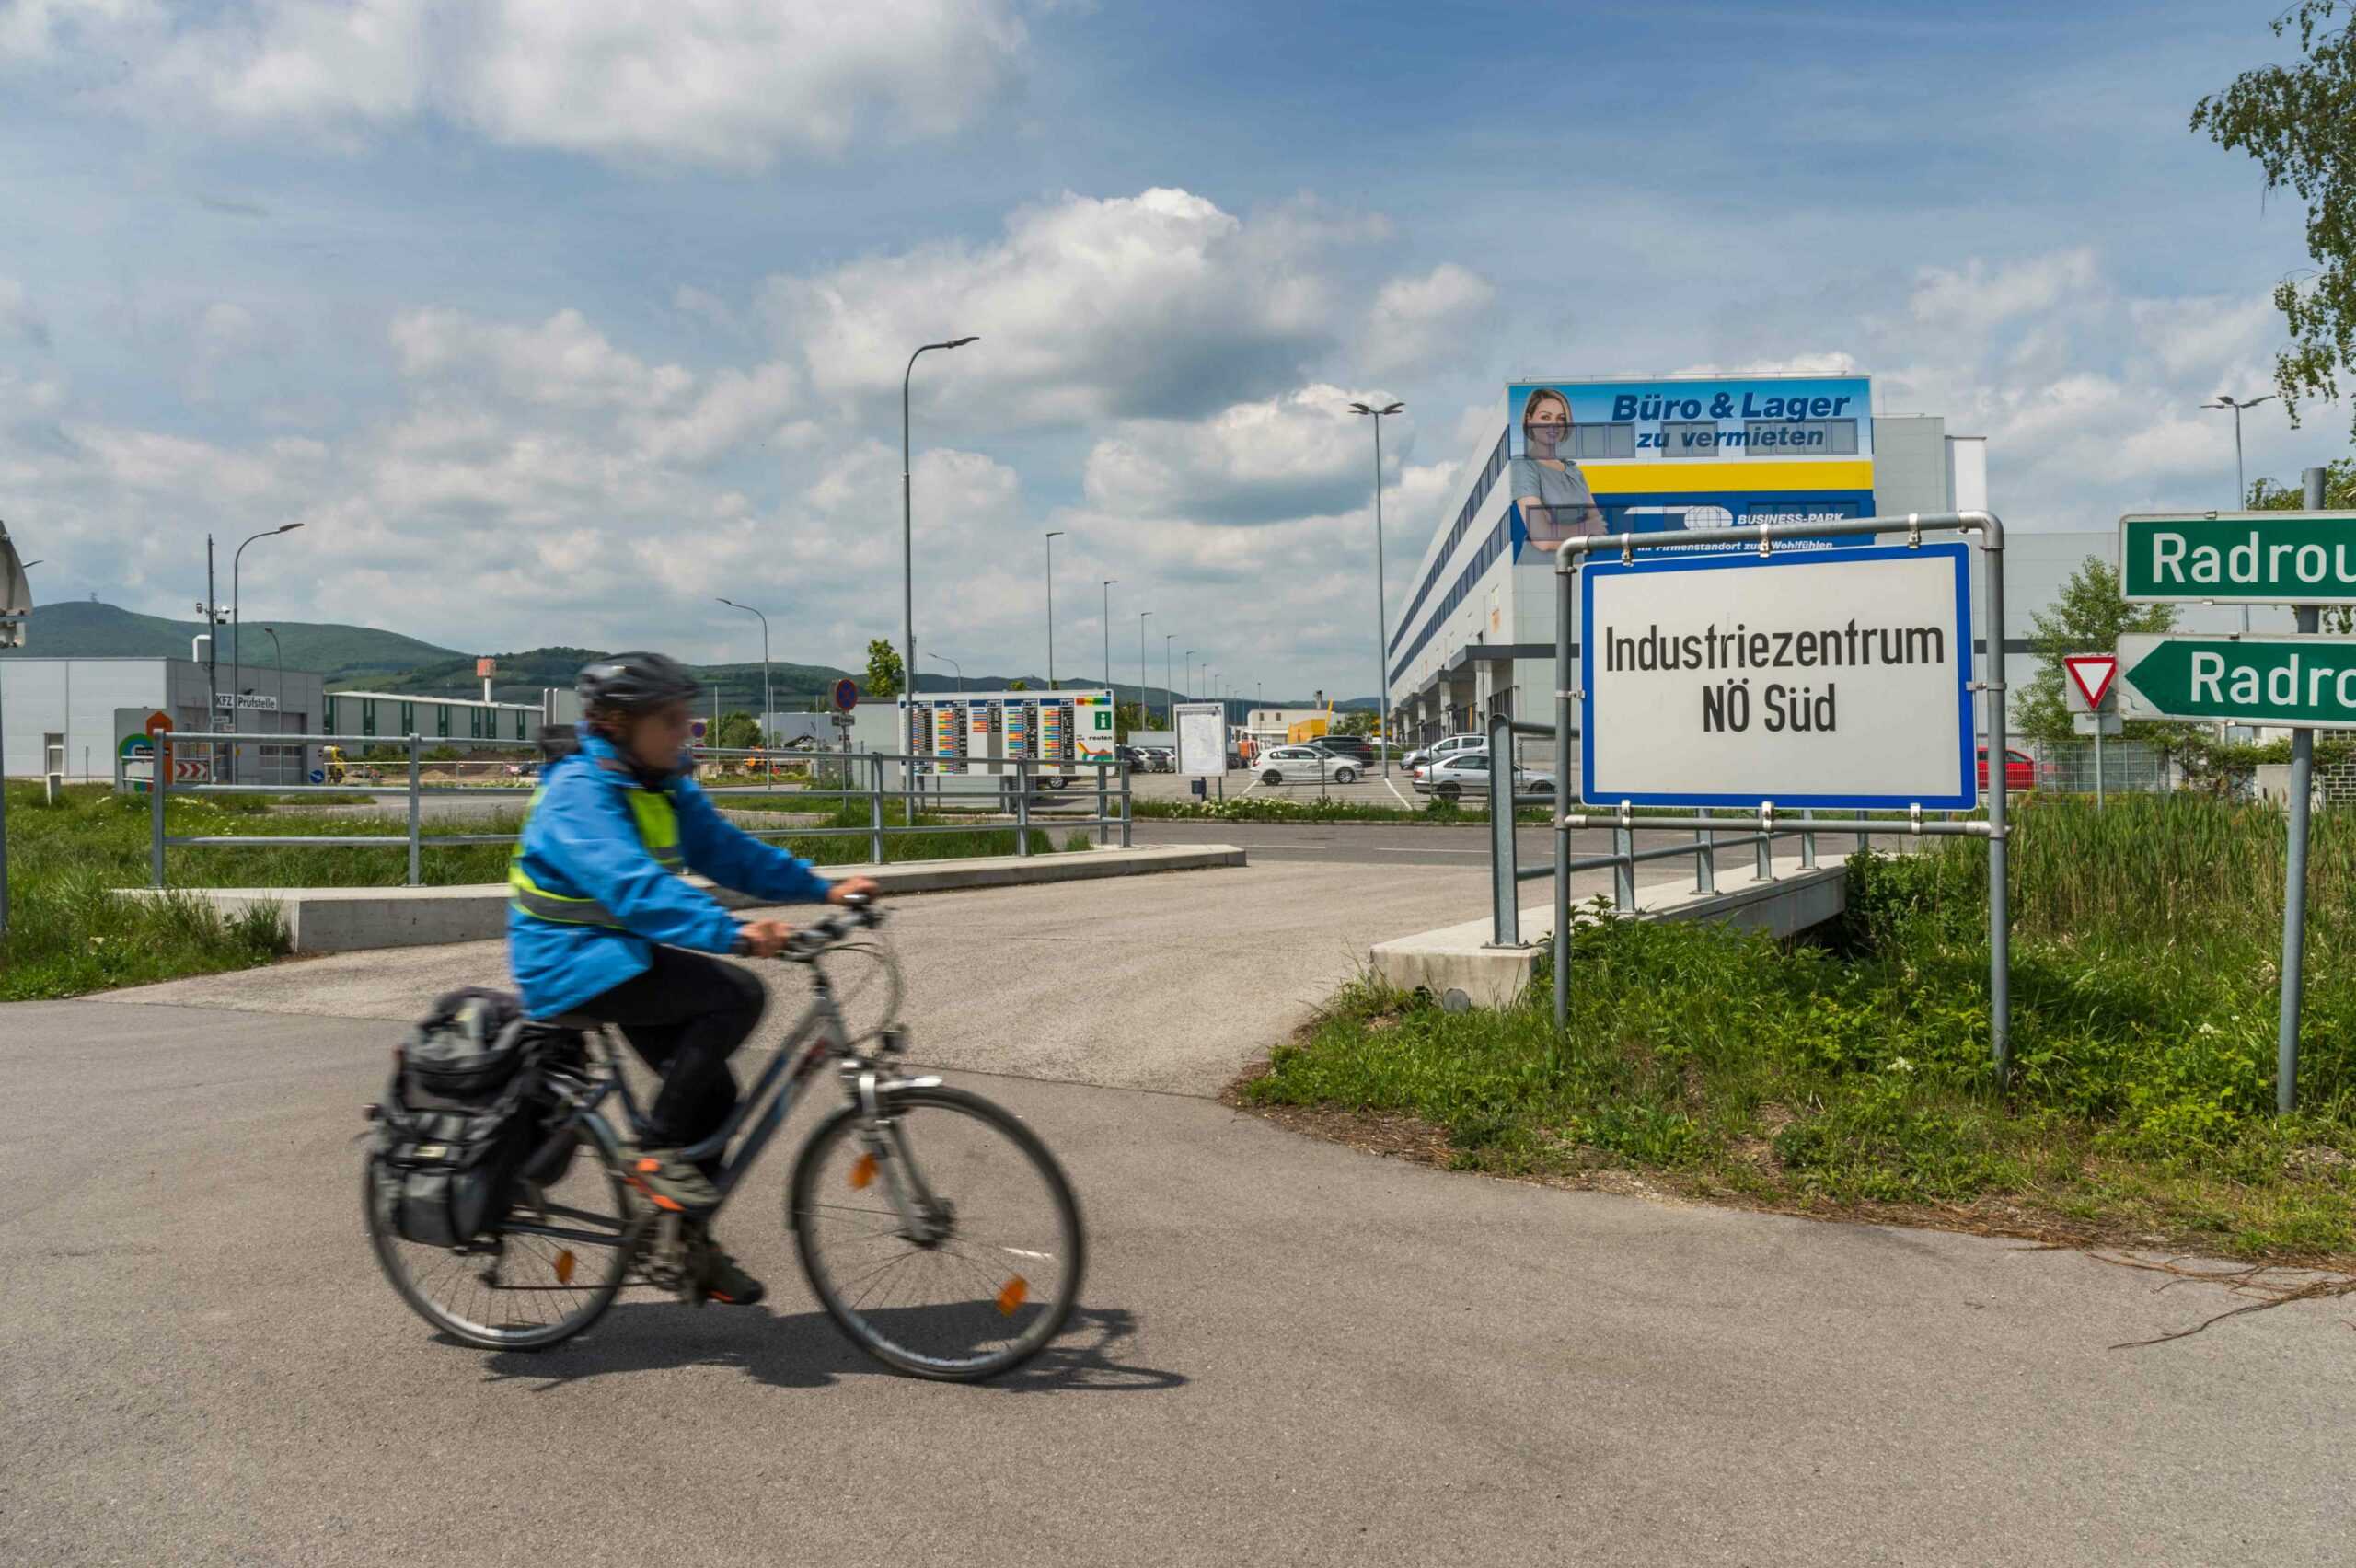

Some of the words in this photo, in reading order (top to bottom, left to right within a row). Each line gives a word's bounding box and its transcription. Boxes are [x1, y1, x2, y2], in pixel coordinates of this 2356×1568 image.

[1612, 393, 1702, 421] Büro
[1709, 392, 1734, 418] &
[1741, 392, 1852, 422] Lager
[1636, 432, 1670, 448] zu
[1681, 426, 1824, 448] vermieten
[1737, 513, 1844, 525] BUSINESS-PARK
[1771, 540, 1833, 550] Wohlfühlen
[2153, 531, 2356, 584] Radrou
[1606, 618, 1944, 672] Industriezentrum
[2190, 651, 2356, 708] Radro
[214, 695, 233, 707] KFZ
[237, 696, 275, 709] Prüfstelle
[1703, 678, 1750, 732] NÖ
[1764, 683, 1836, 732] Süd
